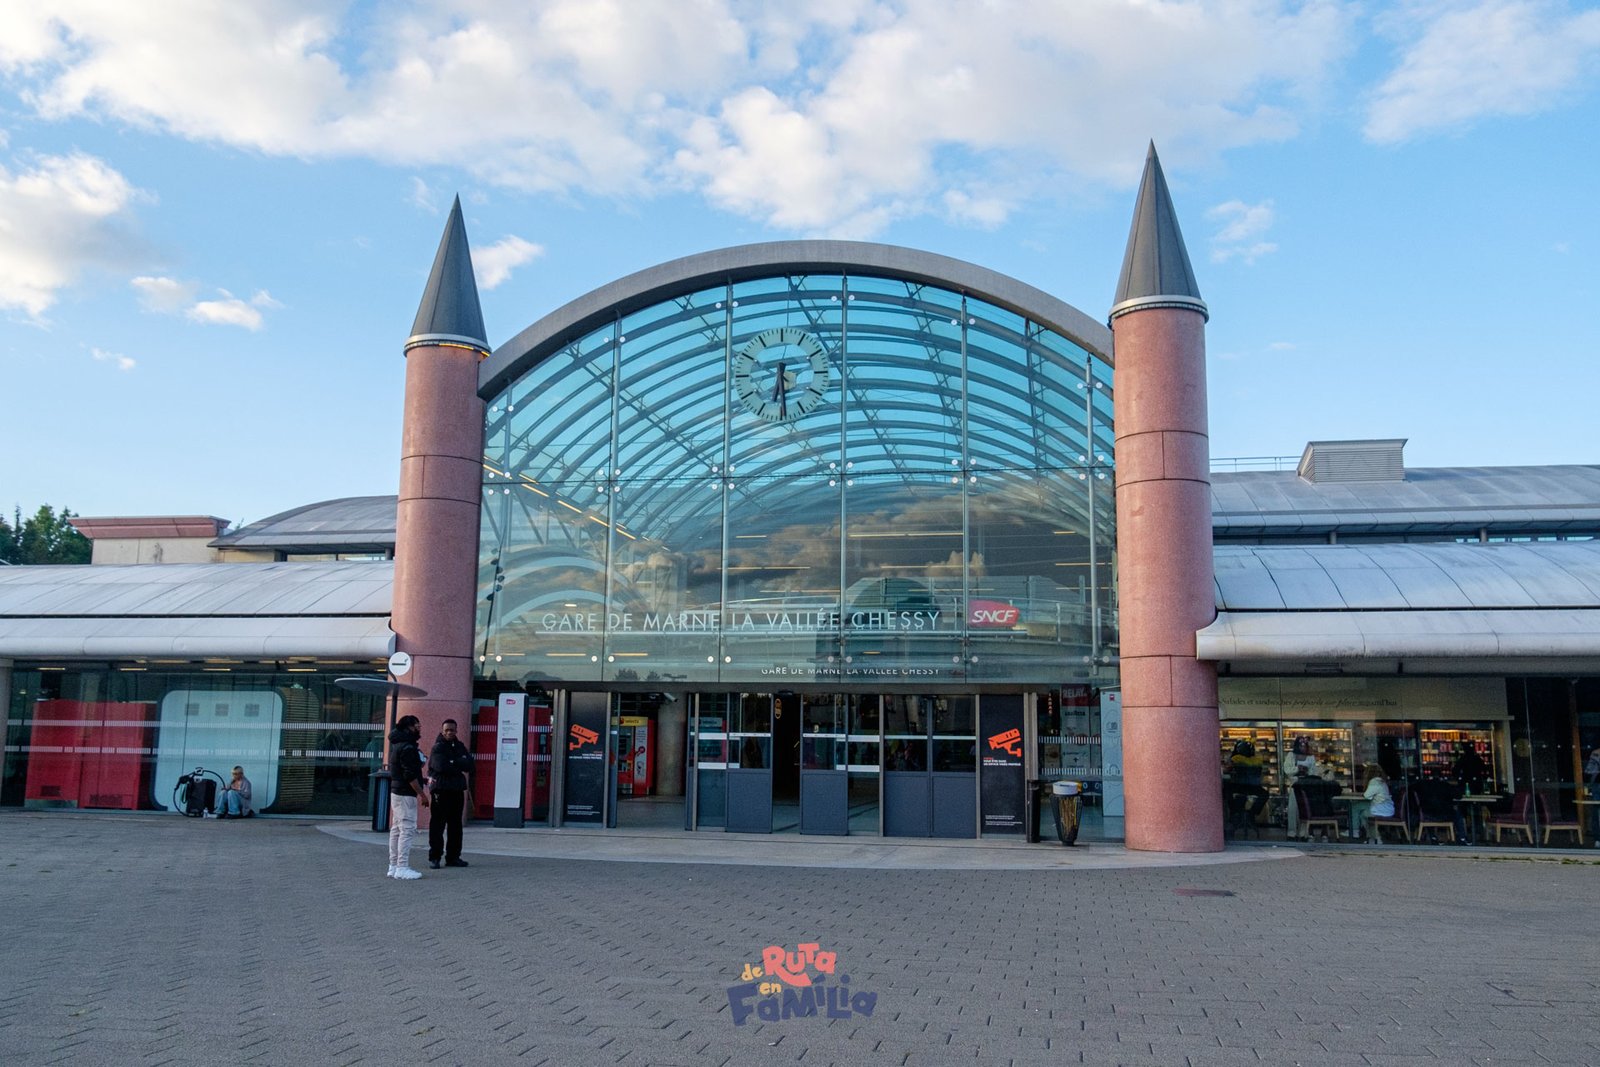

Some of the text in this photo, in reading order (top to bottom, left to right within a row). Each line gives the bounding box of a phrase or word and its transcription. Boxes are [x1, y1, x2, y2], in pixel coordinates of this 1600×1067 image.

[542, 608, 940, 630] GARE DE MARNE LA VALLÉE CHESSY
[972, 610, 1016, 623] SNCF
[761, 667, 787, 675] GARE
[790, 667, 804, 675] DE
